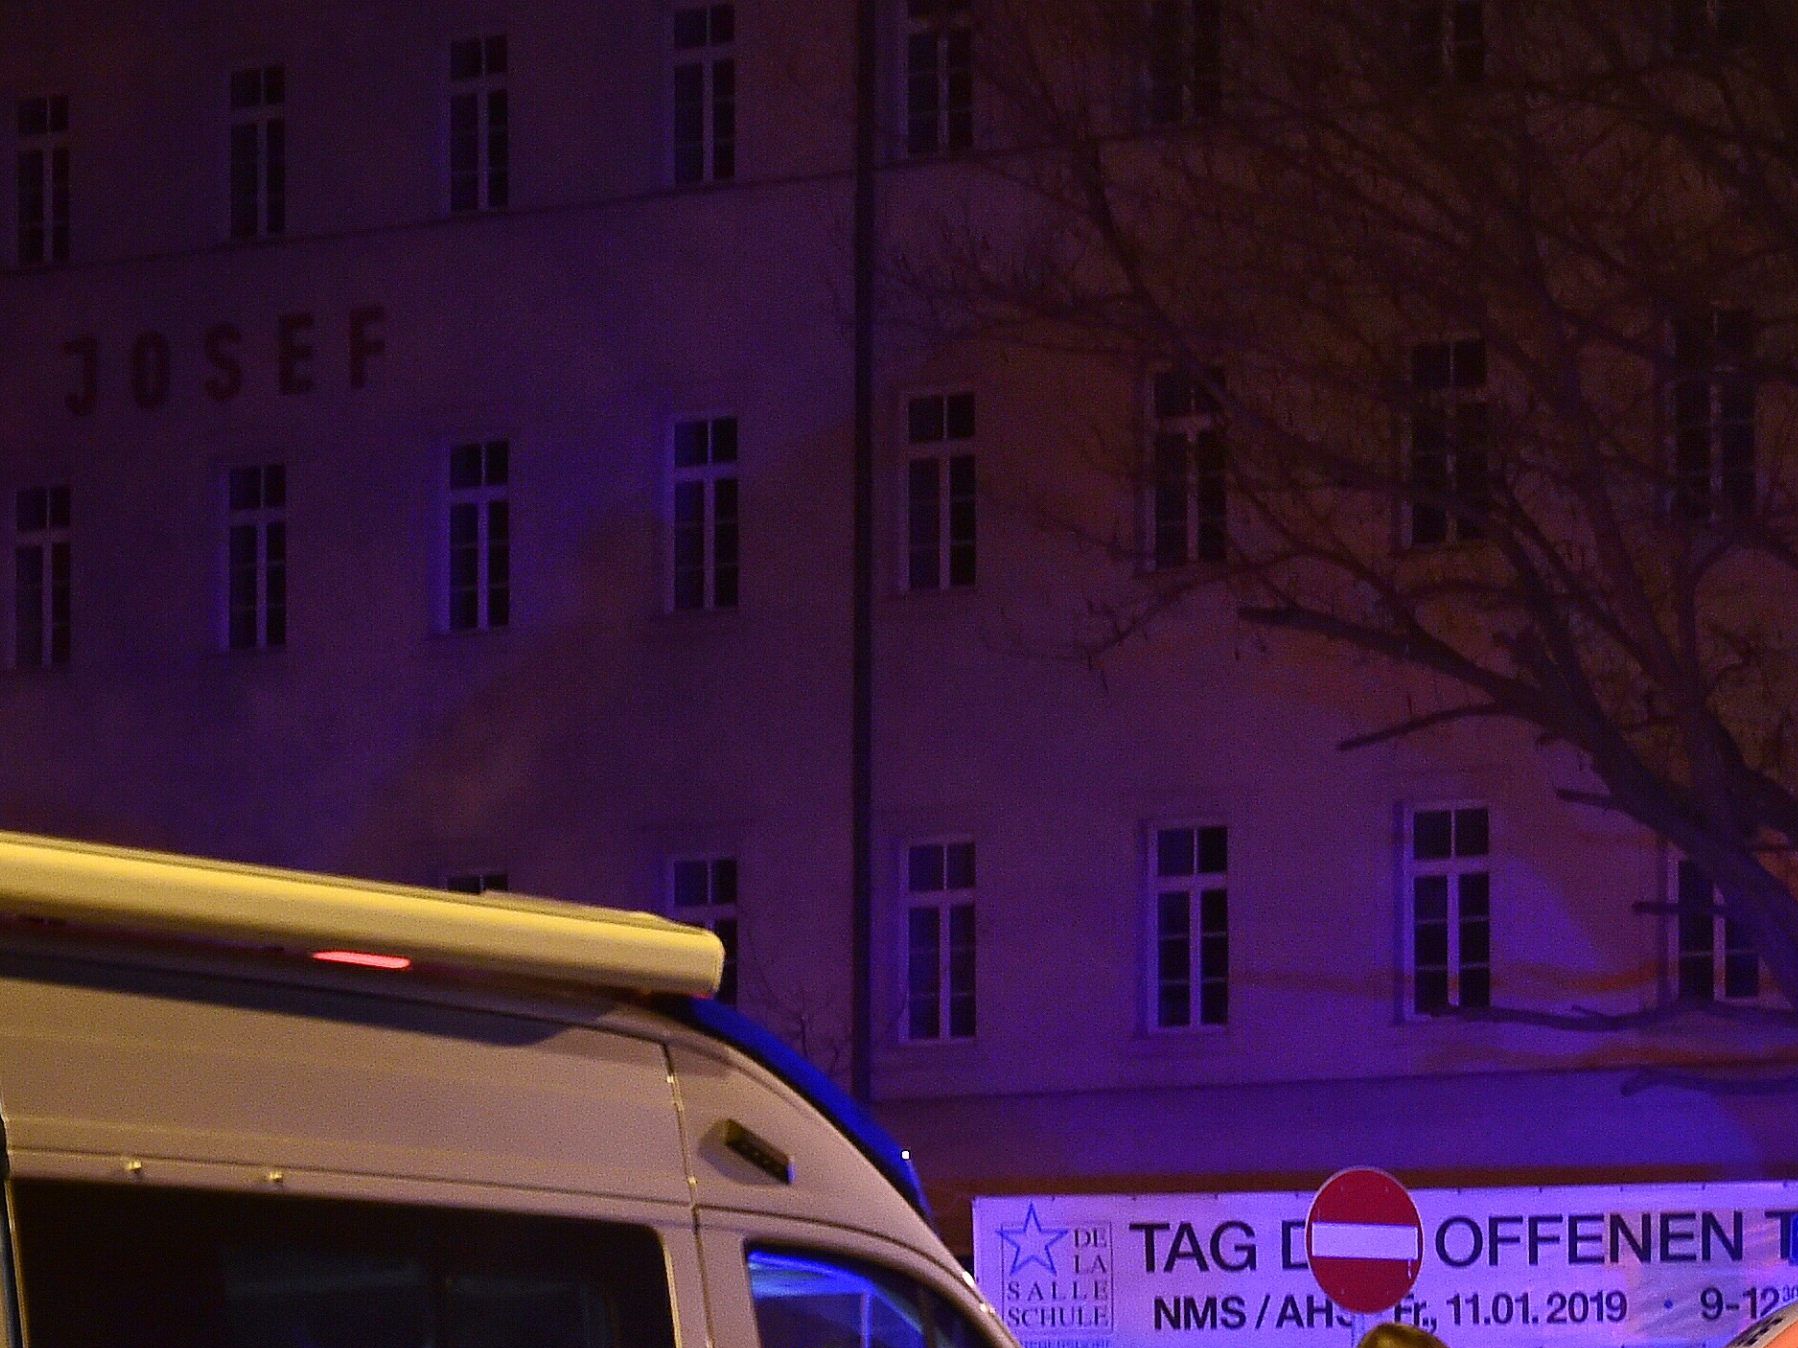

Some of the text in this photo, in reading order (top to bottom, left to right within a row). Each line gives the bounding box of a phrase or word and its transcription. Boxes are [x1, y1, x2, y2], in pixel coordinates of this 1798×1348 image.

[64, 304, 388, 418] JOSEF
[1073, 1228, 1107, 1248] DE
[1129, 1220, 1257, 1274] TAG
[1434, 1210, 1744, 1268] OFFENEN
[1073, 1255, 1107, 1274] LA
[1007, 1281, 1108, 1301] SALLE
[1008, 1306, 1109, 1328] SCHULE
[1546, 1289, 1628, 1325] 2019
